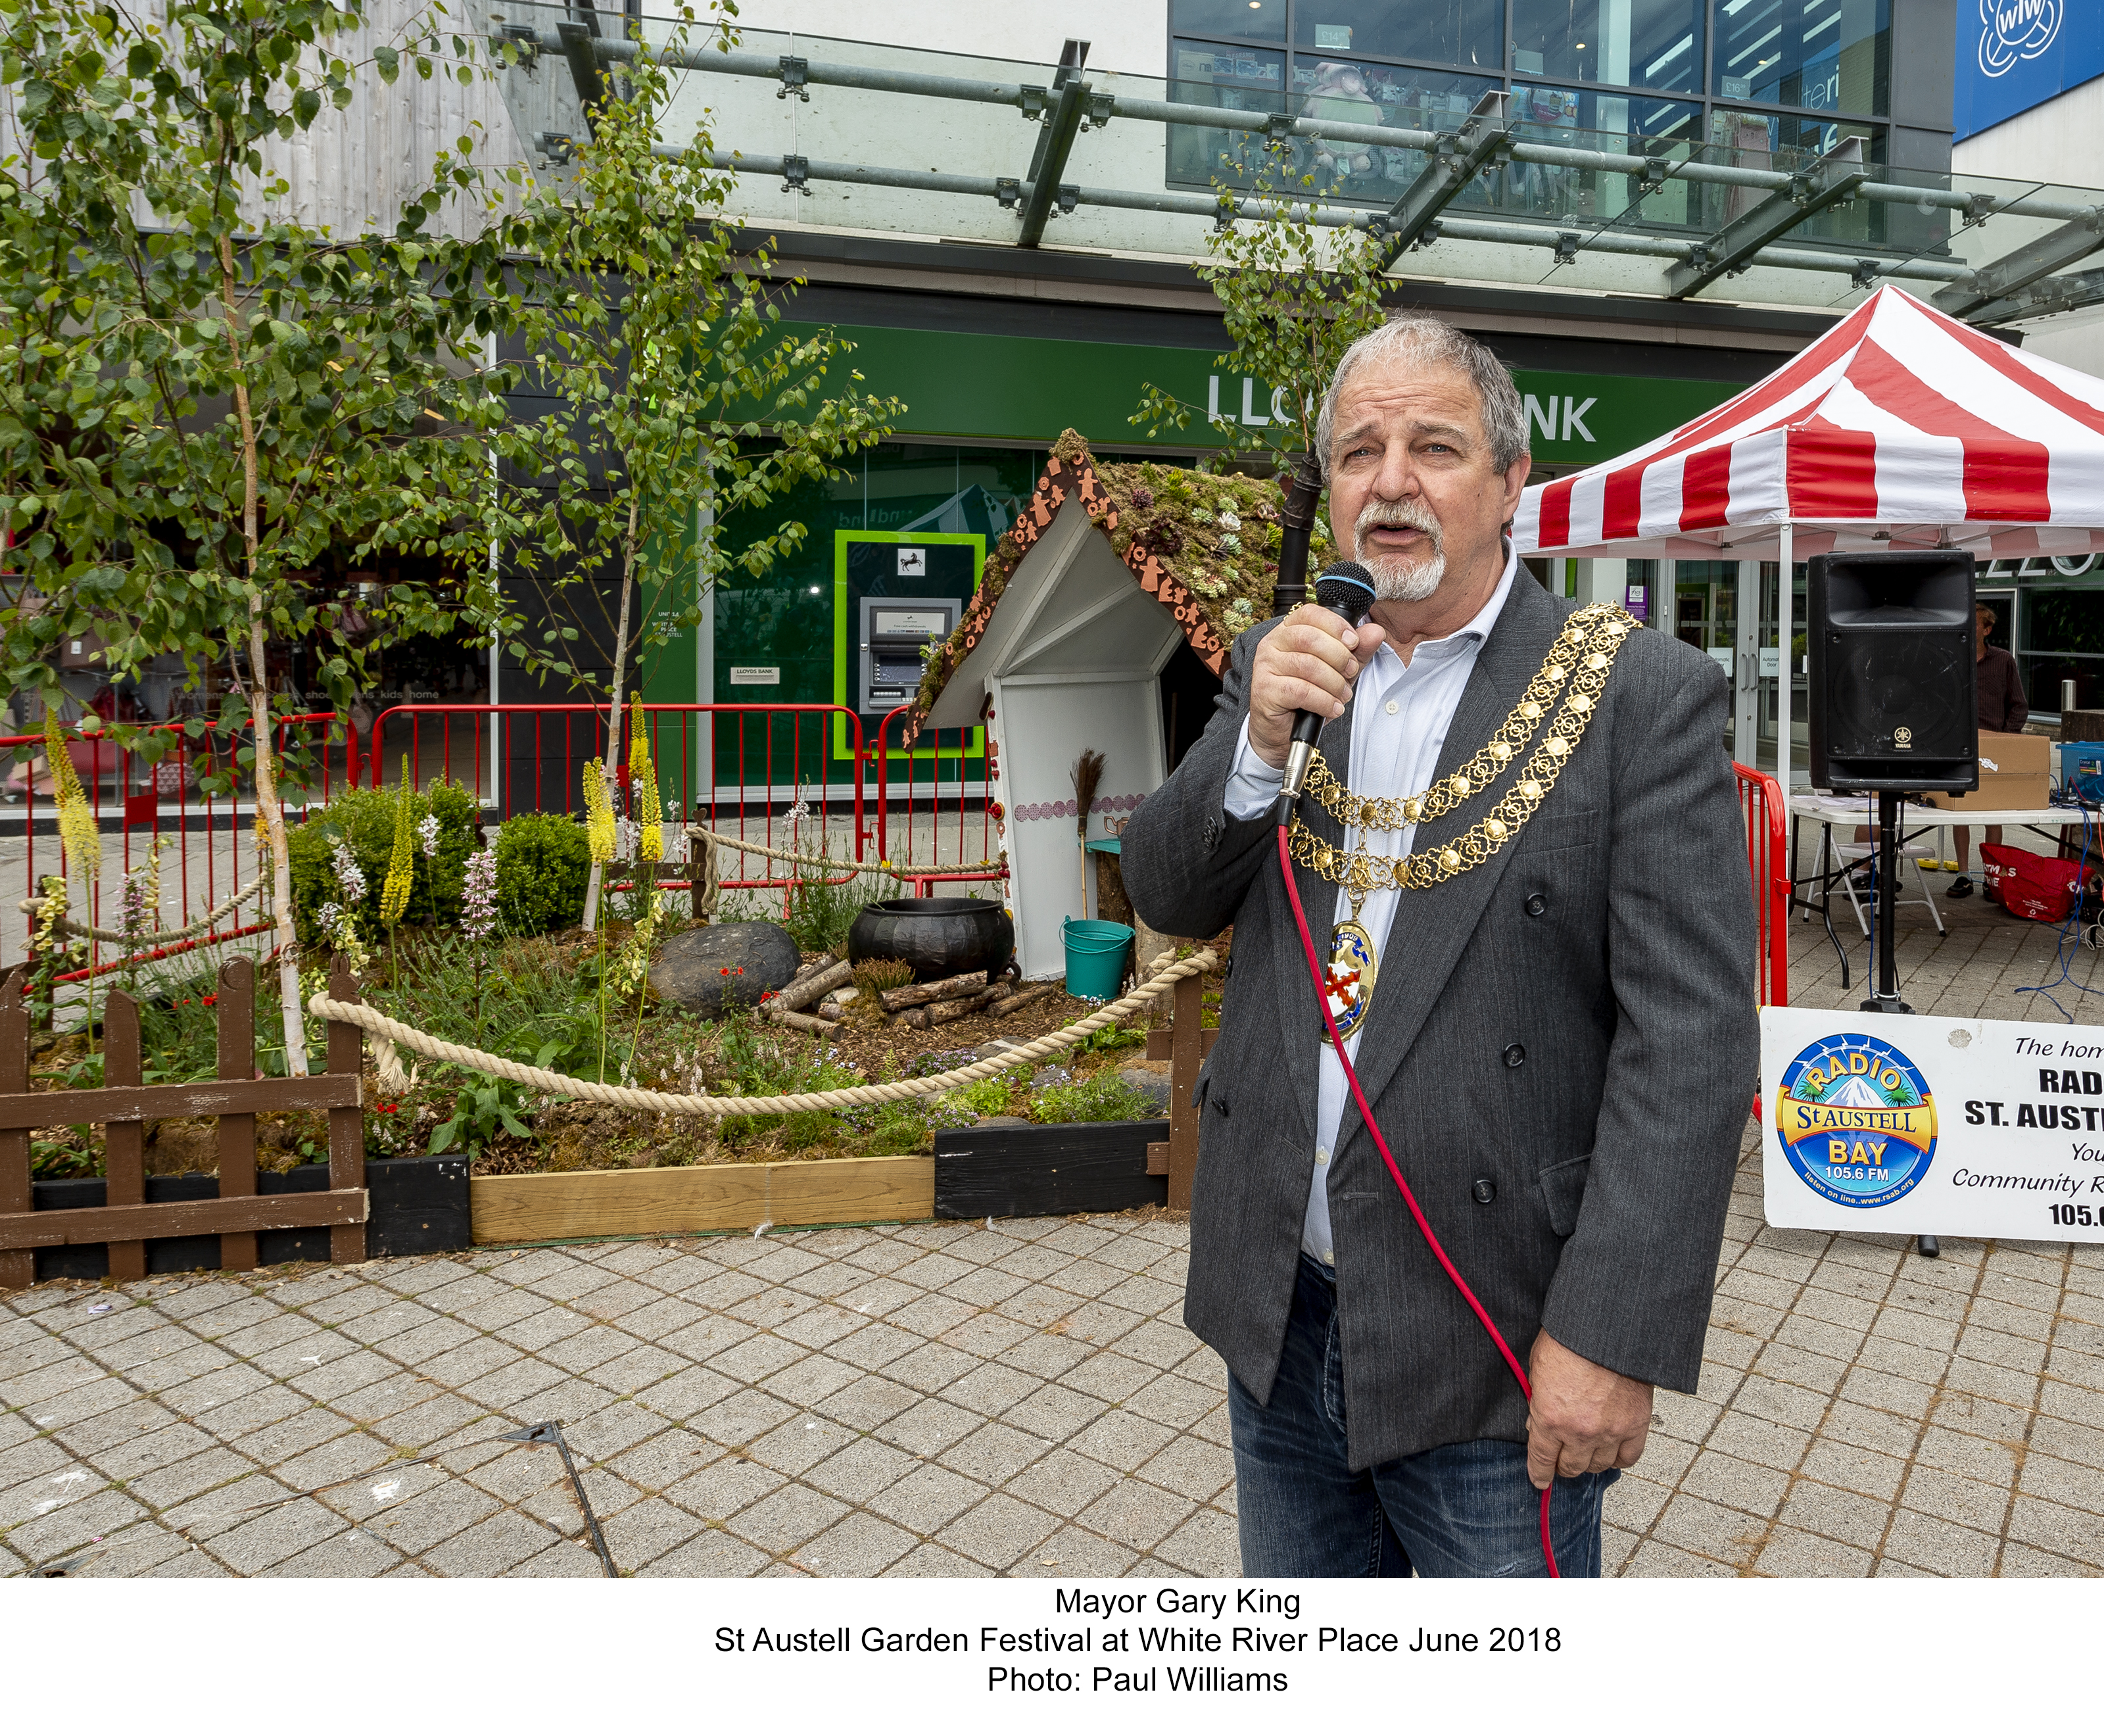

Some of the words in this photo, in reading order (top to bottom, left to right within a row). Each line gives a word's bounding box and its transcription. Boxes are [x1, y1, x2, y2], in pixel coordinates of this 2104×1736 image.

[1523, 394, 1598, 442] NK
[381, 690, 403, 698] kids
[409, 690, 439, 699] home
[2016, 1037, 2053, 1055] The
[1805, 1051, 1901, 1094] RADIO
[1797, 1105, 1821, 1130] St
[1822, 1109, 1917, 1133] AUSTELL
[1965, 1100, 2009, 1126] ST.
[2017, 1103, 2104, 1131] AUST
[1829, 1140, 1889, 1166] BAY
[1804, 1171, 1827, 1193] listen
[1827, 1190, 1838, 1199] on
[1825, 1166, 1864, 1180] 105.6
[1868, 1168, 1889, 1182] FM
[1952, 1169, 2085, 1199] Community
